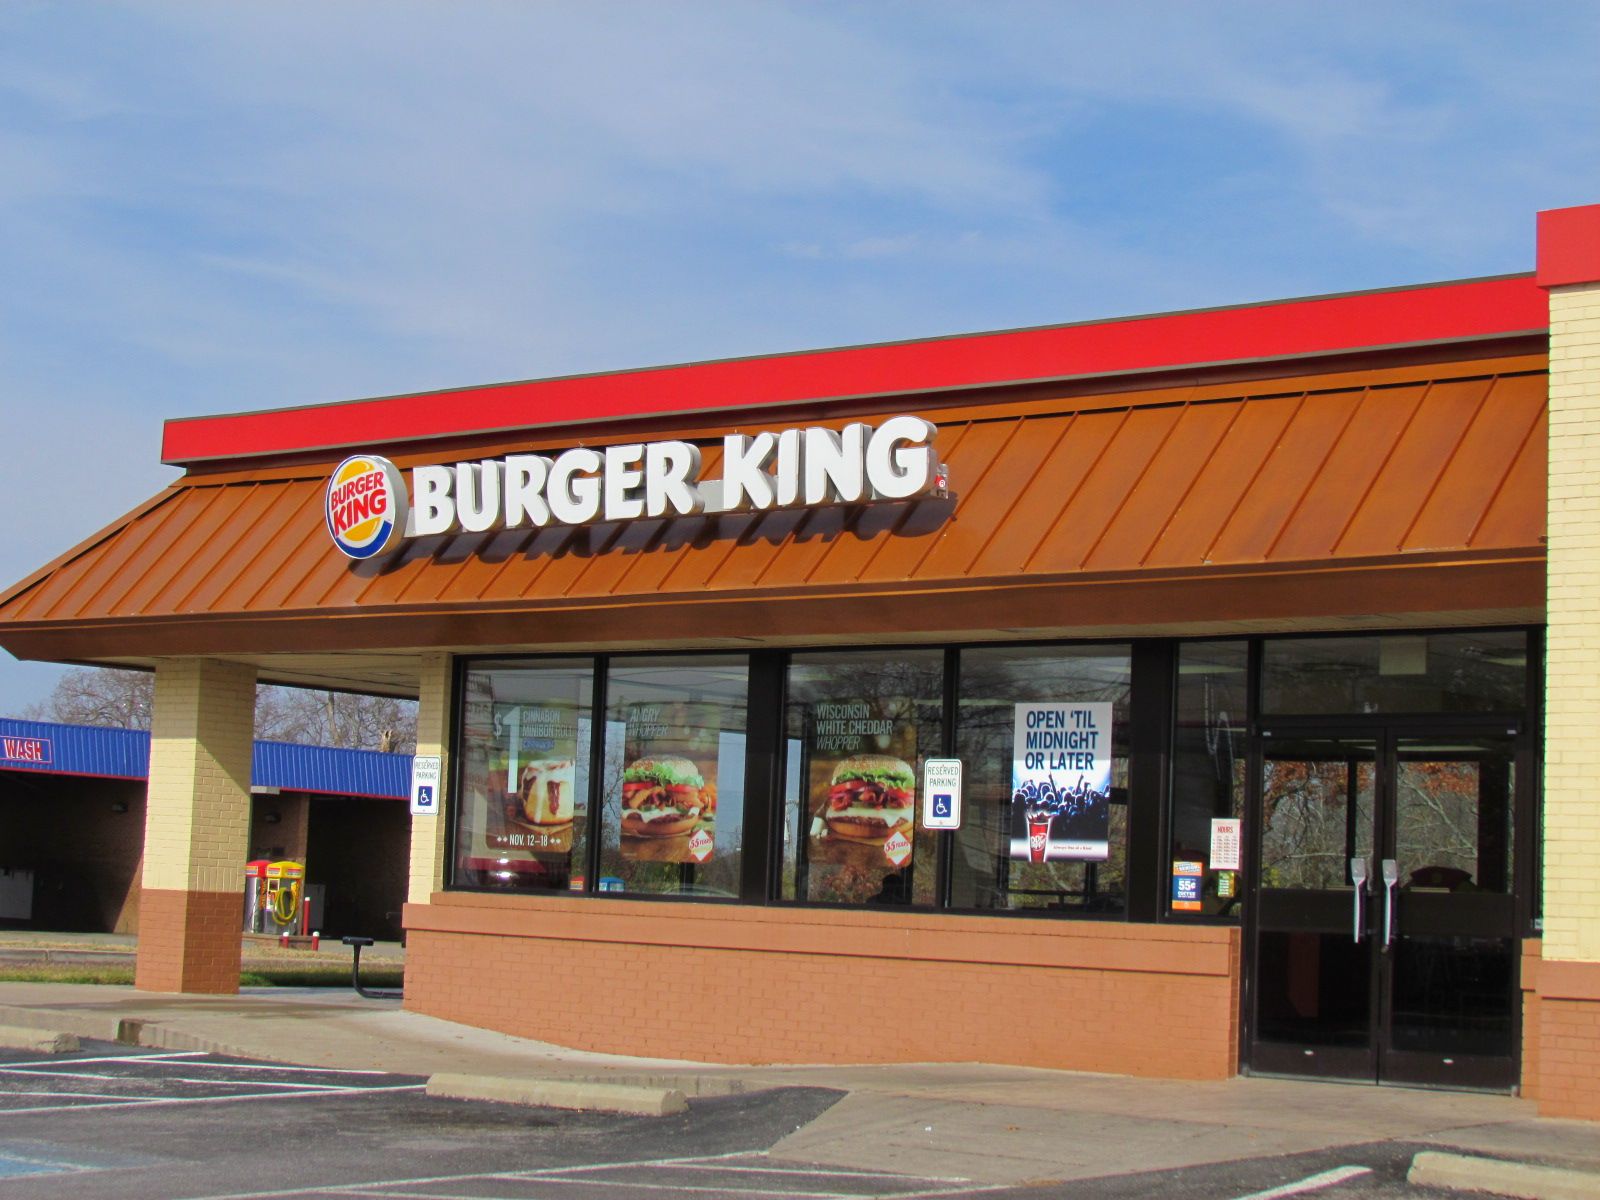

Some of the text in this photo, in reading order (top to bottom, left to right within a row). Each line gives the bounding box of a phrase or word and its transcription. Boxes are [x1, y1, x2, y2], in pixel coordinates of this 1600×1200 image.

[413, 415, 933, 535] BURGER KING
[331, 471, 385, 511] BURGER
[333, 488, 387, 537] KING
[523, 709, 560, 724] CINNABON
[630, 707, 660, 722] ANGRY
[817, 704, 870, 719] WISCONSIN
[1026, 710, 1065, 729] OPEN
[522, 724, 553, 737] MINIBON
[816, 720, 893, 735] WHITE CHEDDAR
[816, 736, 860, 751] WHOPPER
[1026, 731, 1099, 750] MIDNIGHT
[4, 739, 43, 760] WASH
[416, 761, 439, 770] RESERVED
[1025, 752, 1094, 770] OR LATER
[416, 771, 437, 780] PARKING
[928, 766, 959, 776] RESERVED
[929, 778, 957, 787] PARKING
[1217, 826, 1234, 834] HOURS
[509, 833, 525, 847] NOV.
